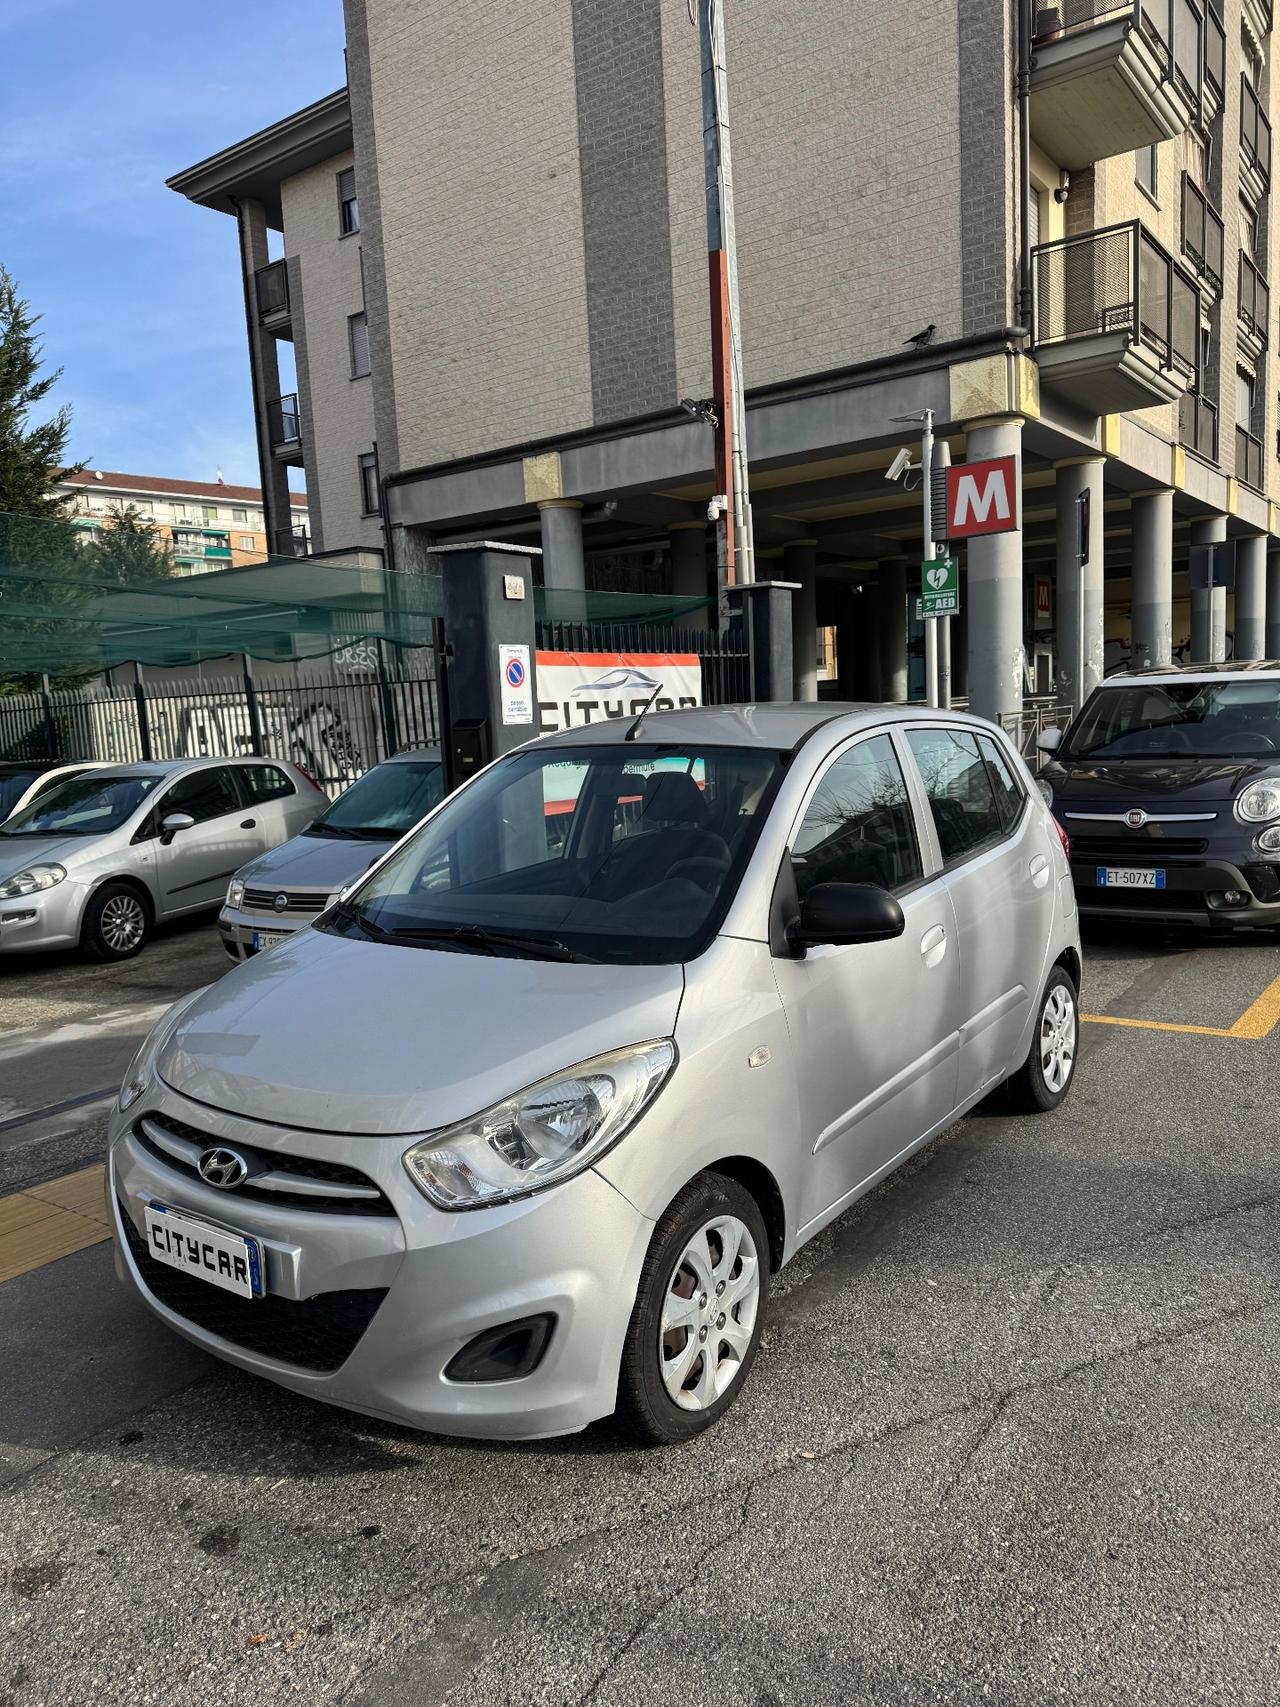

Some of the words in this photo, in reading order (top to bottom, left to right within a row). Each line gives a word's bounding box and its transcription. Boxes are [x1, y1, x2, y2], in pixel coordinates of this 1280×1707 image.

[953, 469, 1011, 527] M
[935, 597, 956, 609] AED
[151, 1223, 248, 1284] CITYCAR
